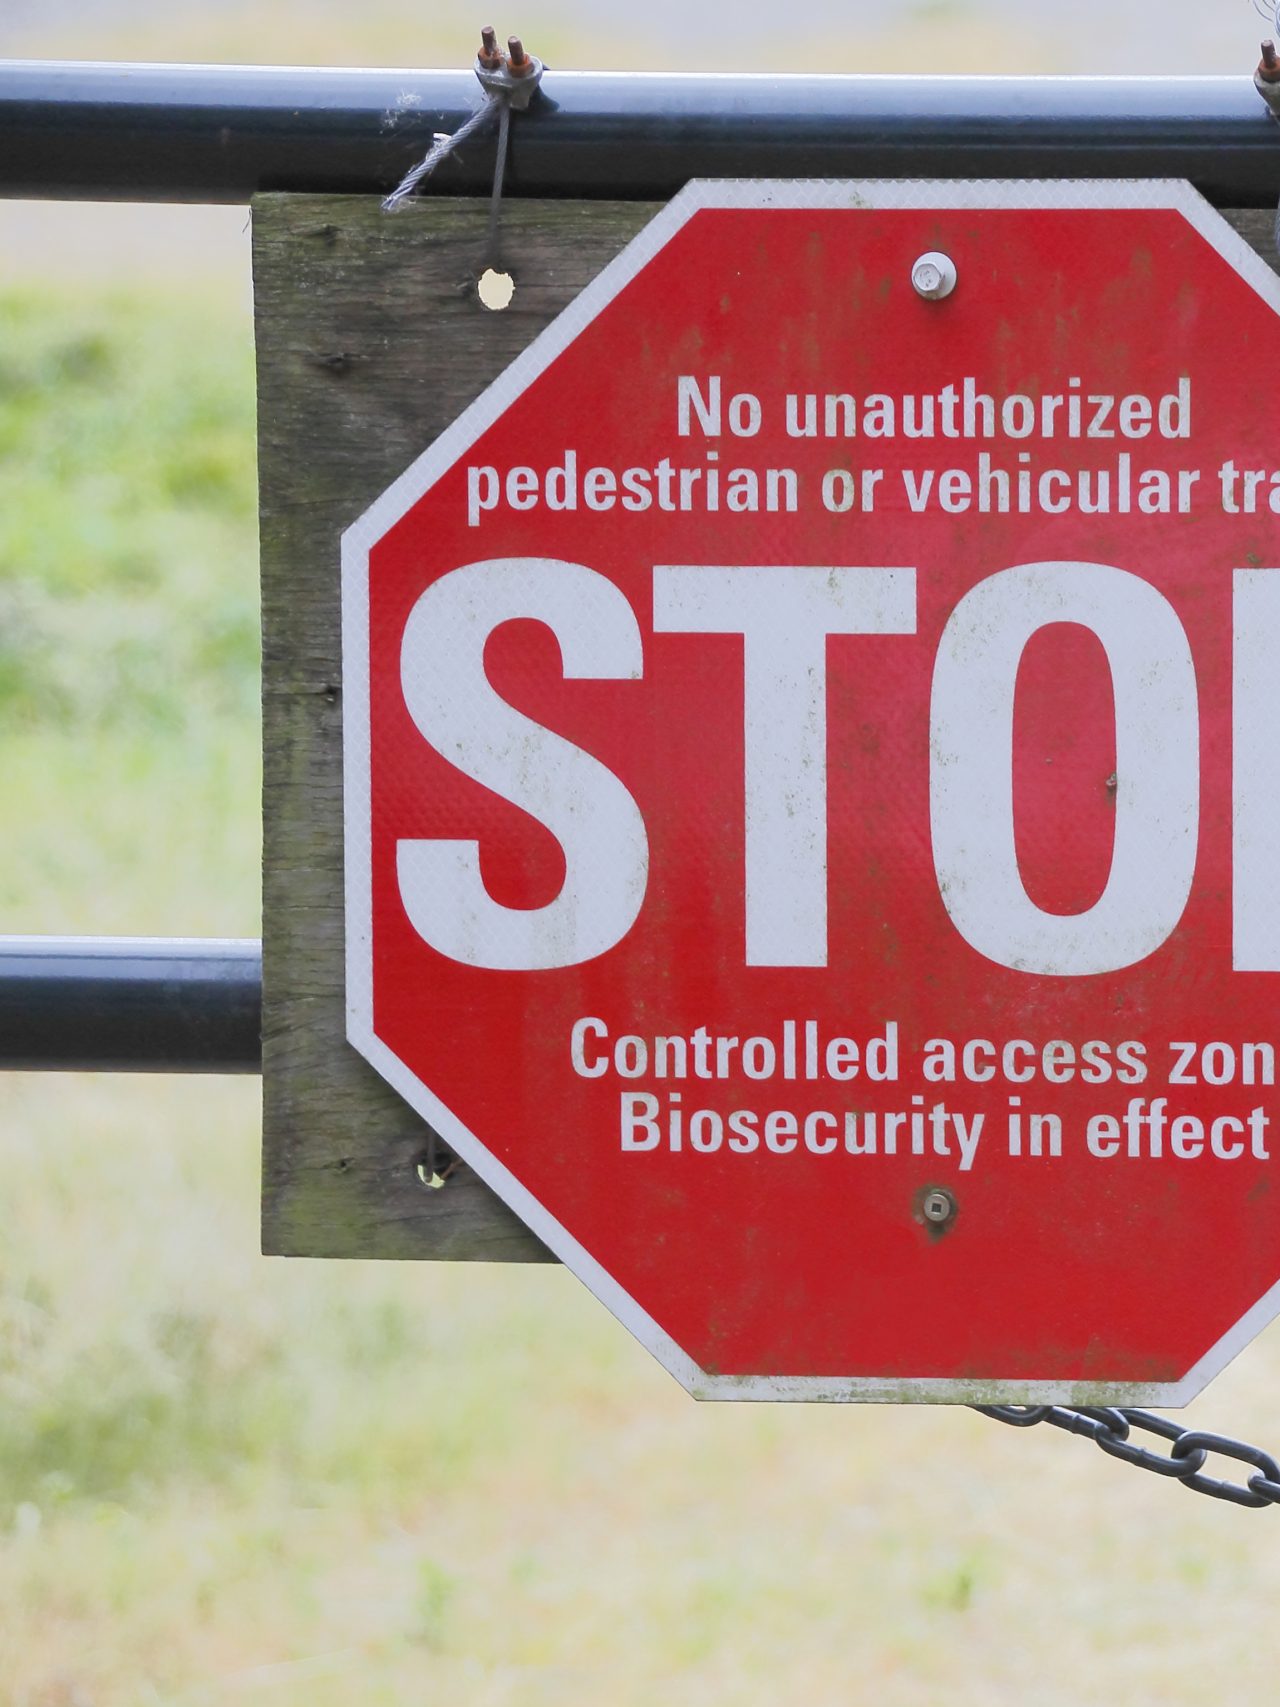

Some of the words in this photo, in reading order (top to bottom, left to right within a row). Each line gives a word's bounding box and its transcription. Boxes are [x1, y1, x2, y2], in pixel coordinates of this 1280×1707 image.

[676, 374, 762, 438] No
[785, 376, 1192, 439] unauthorized
[466, 449, 799, 527] pedestrian
[821, 468, 885, 513] or
[901, 452, 1201, 515] vehicular
[570, 1016, 899, 1082] Controlled
[922, 1038, 1148, 1086] access
[619, 1091, 985, 1171] Biosecurity
[1007, 1096, 1063, 1157] in
[1086, 1096, 1271, 1161] effect
